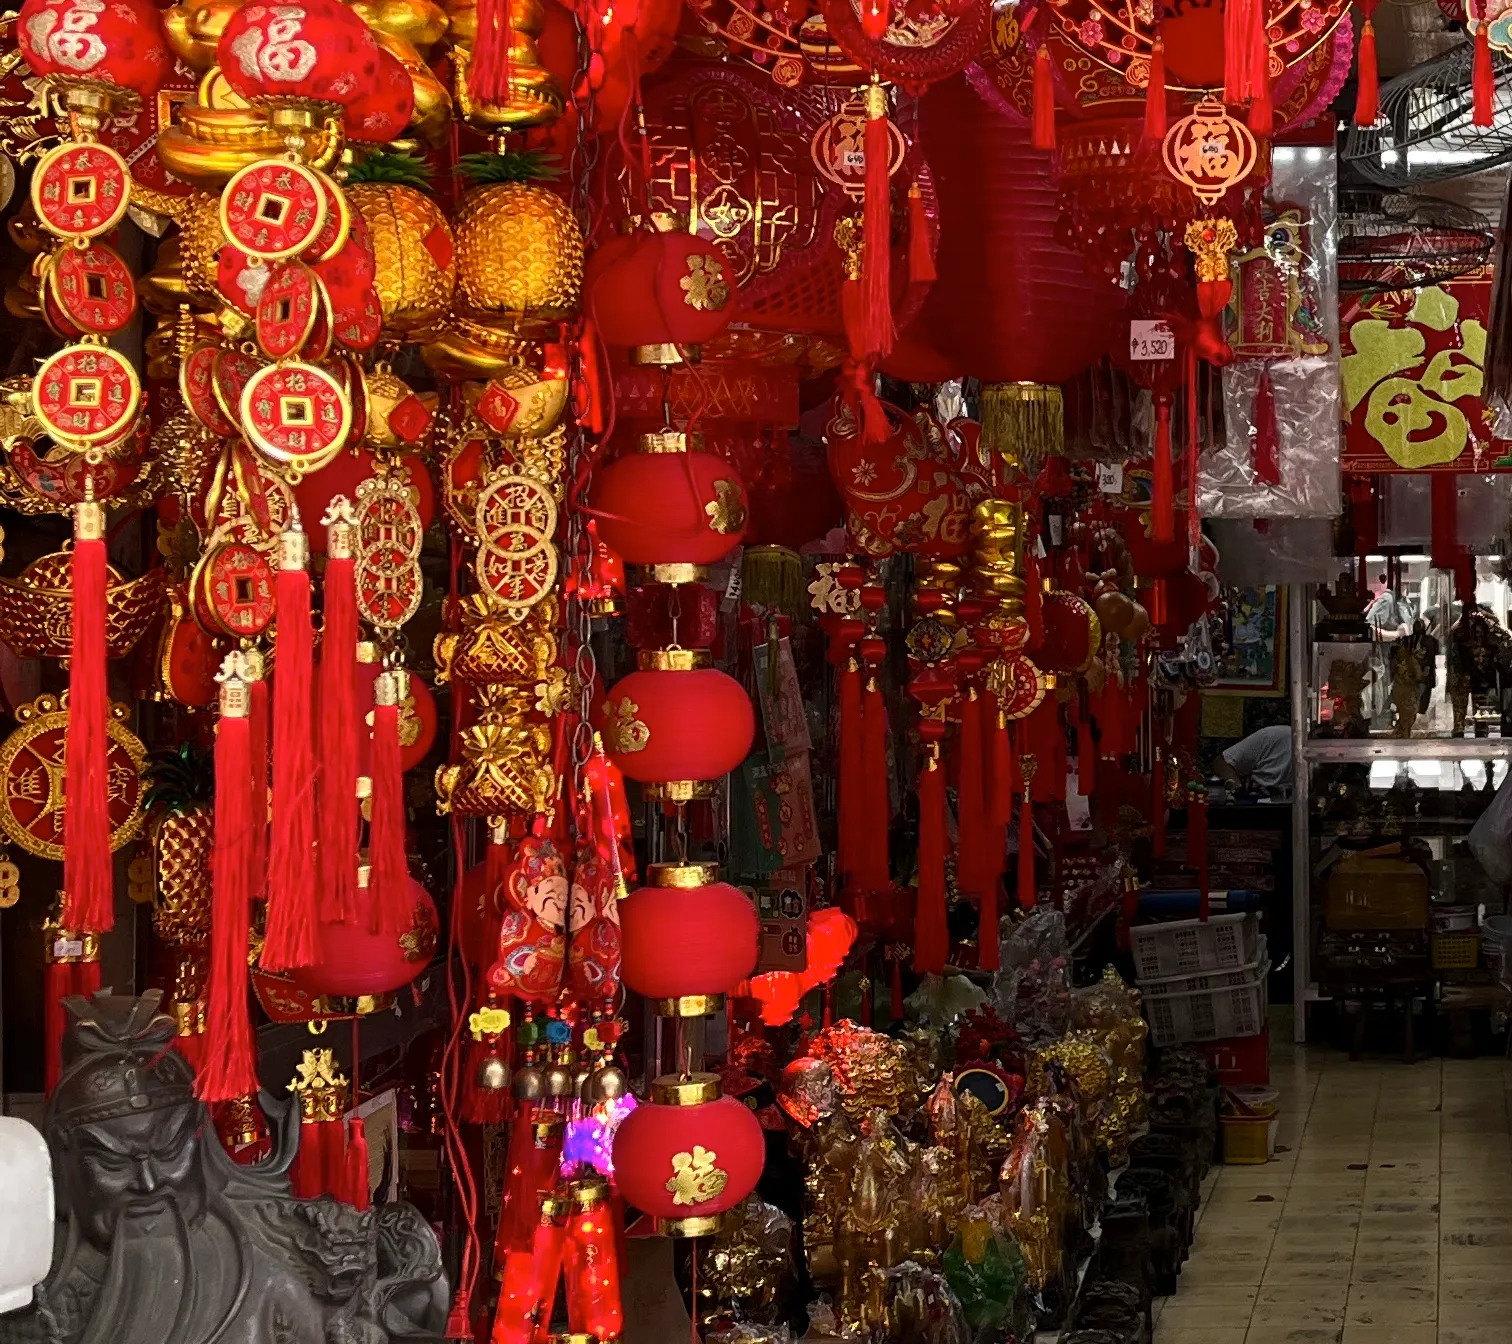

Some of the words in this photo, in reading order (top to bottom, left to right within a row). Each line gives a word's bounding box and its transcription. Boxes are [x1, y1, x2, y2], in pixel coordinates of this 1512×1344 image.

[231, 2, 317, 84] 福
[1179, 121, 1240, 179] 福
[1340, 286, 1488, 469] 福
